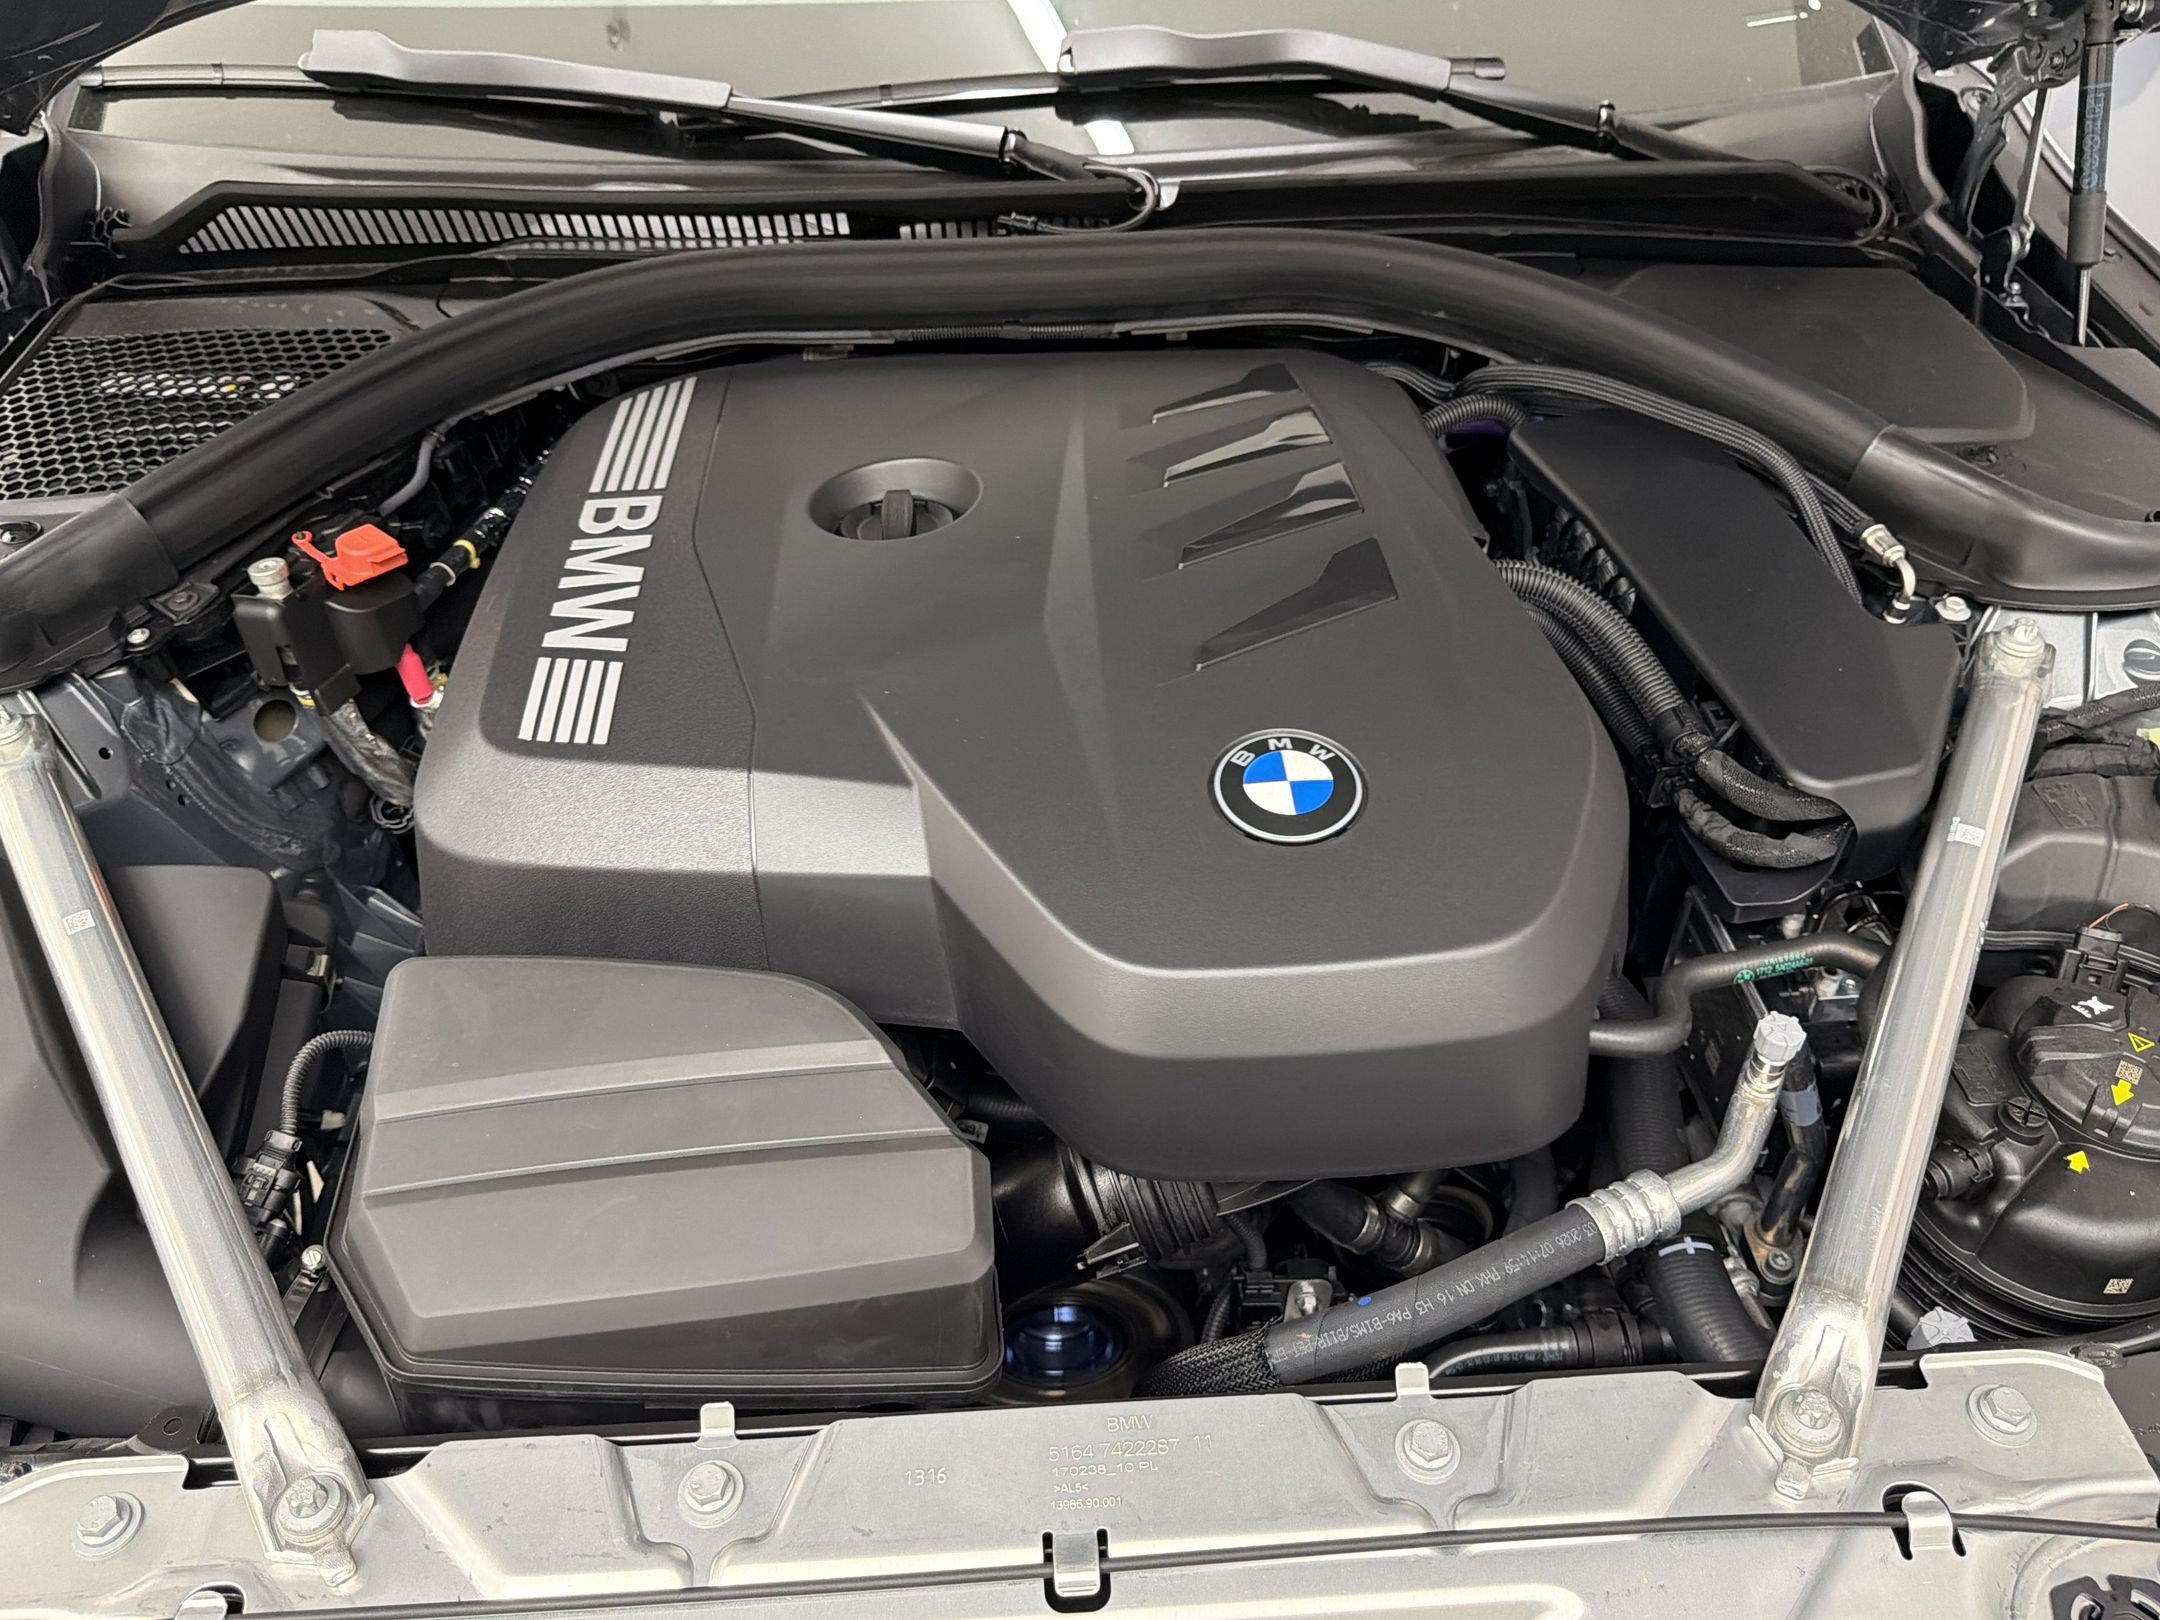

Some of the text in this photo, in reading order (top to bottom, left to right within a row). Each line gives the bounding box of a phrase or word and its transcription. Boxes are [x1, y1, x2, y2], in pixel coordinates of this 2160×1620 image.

[541, 494, 664, 653] BMW
[1230, 737, 1336, 767] BMW
[1107, 1415, 1152, 1432] BMW
[1049, 1444, 1094, 1462] 5164
[1100, 1438, 1180, 1458] 7422287
[905, 1467, 946, 1486] 1316
